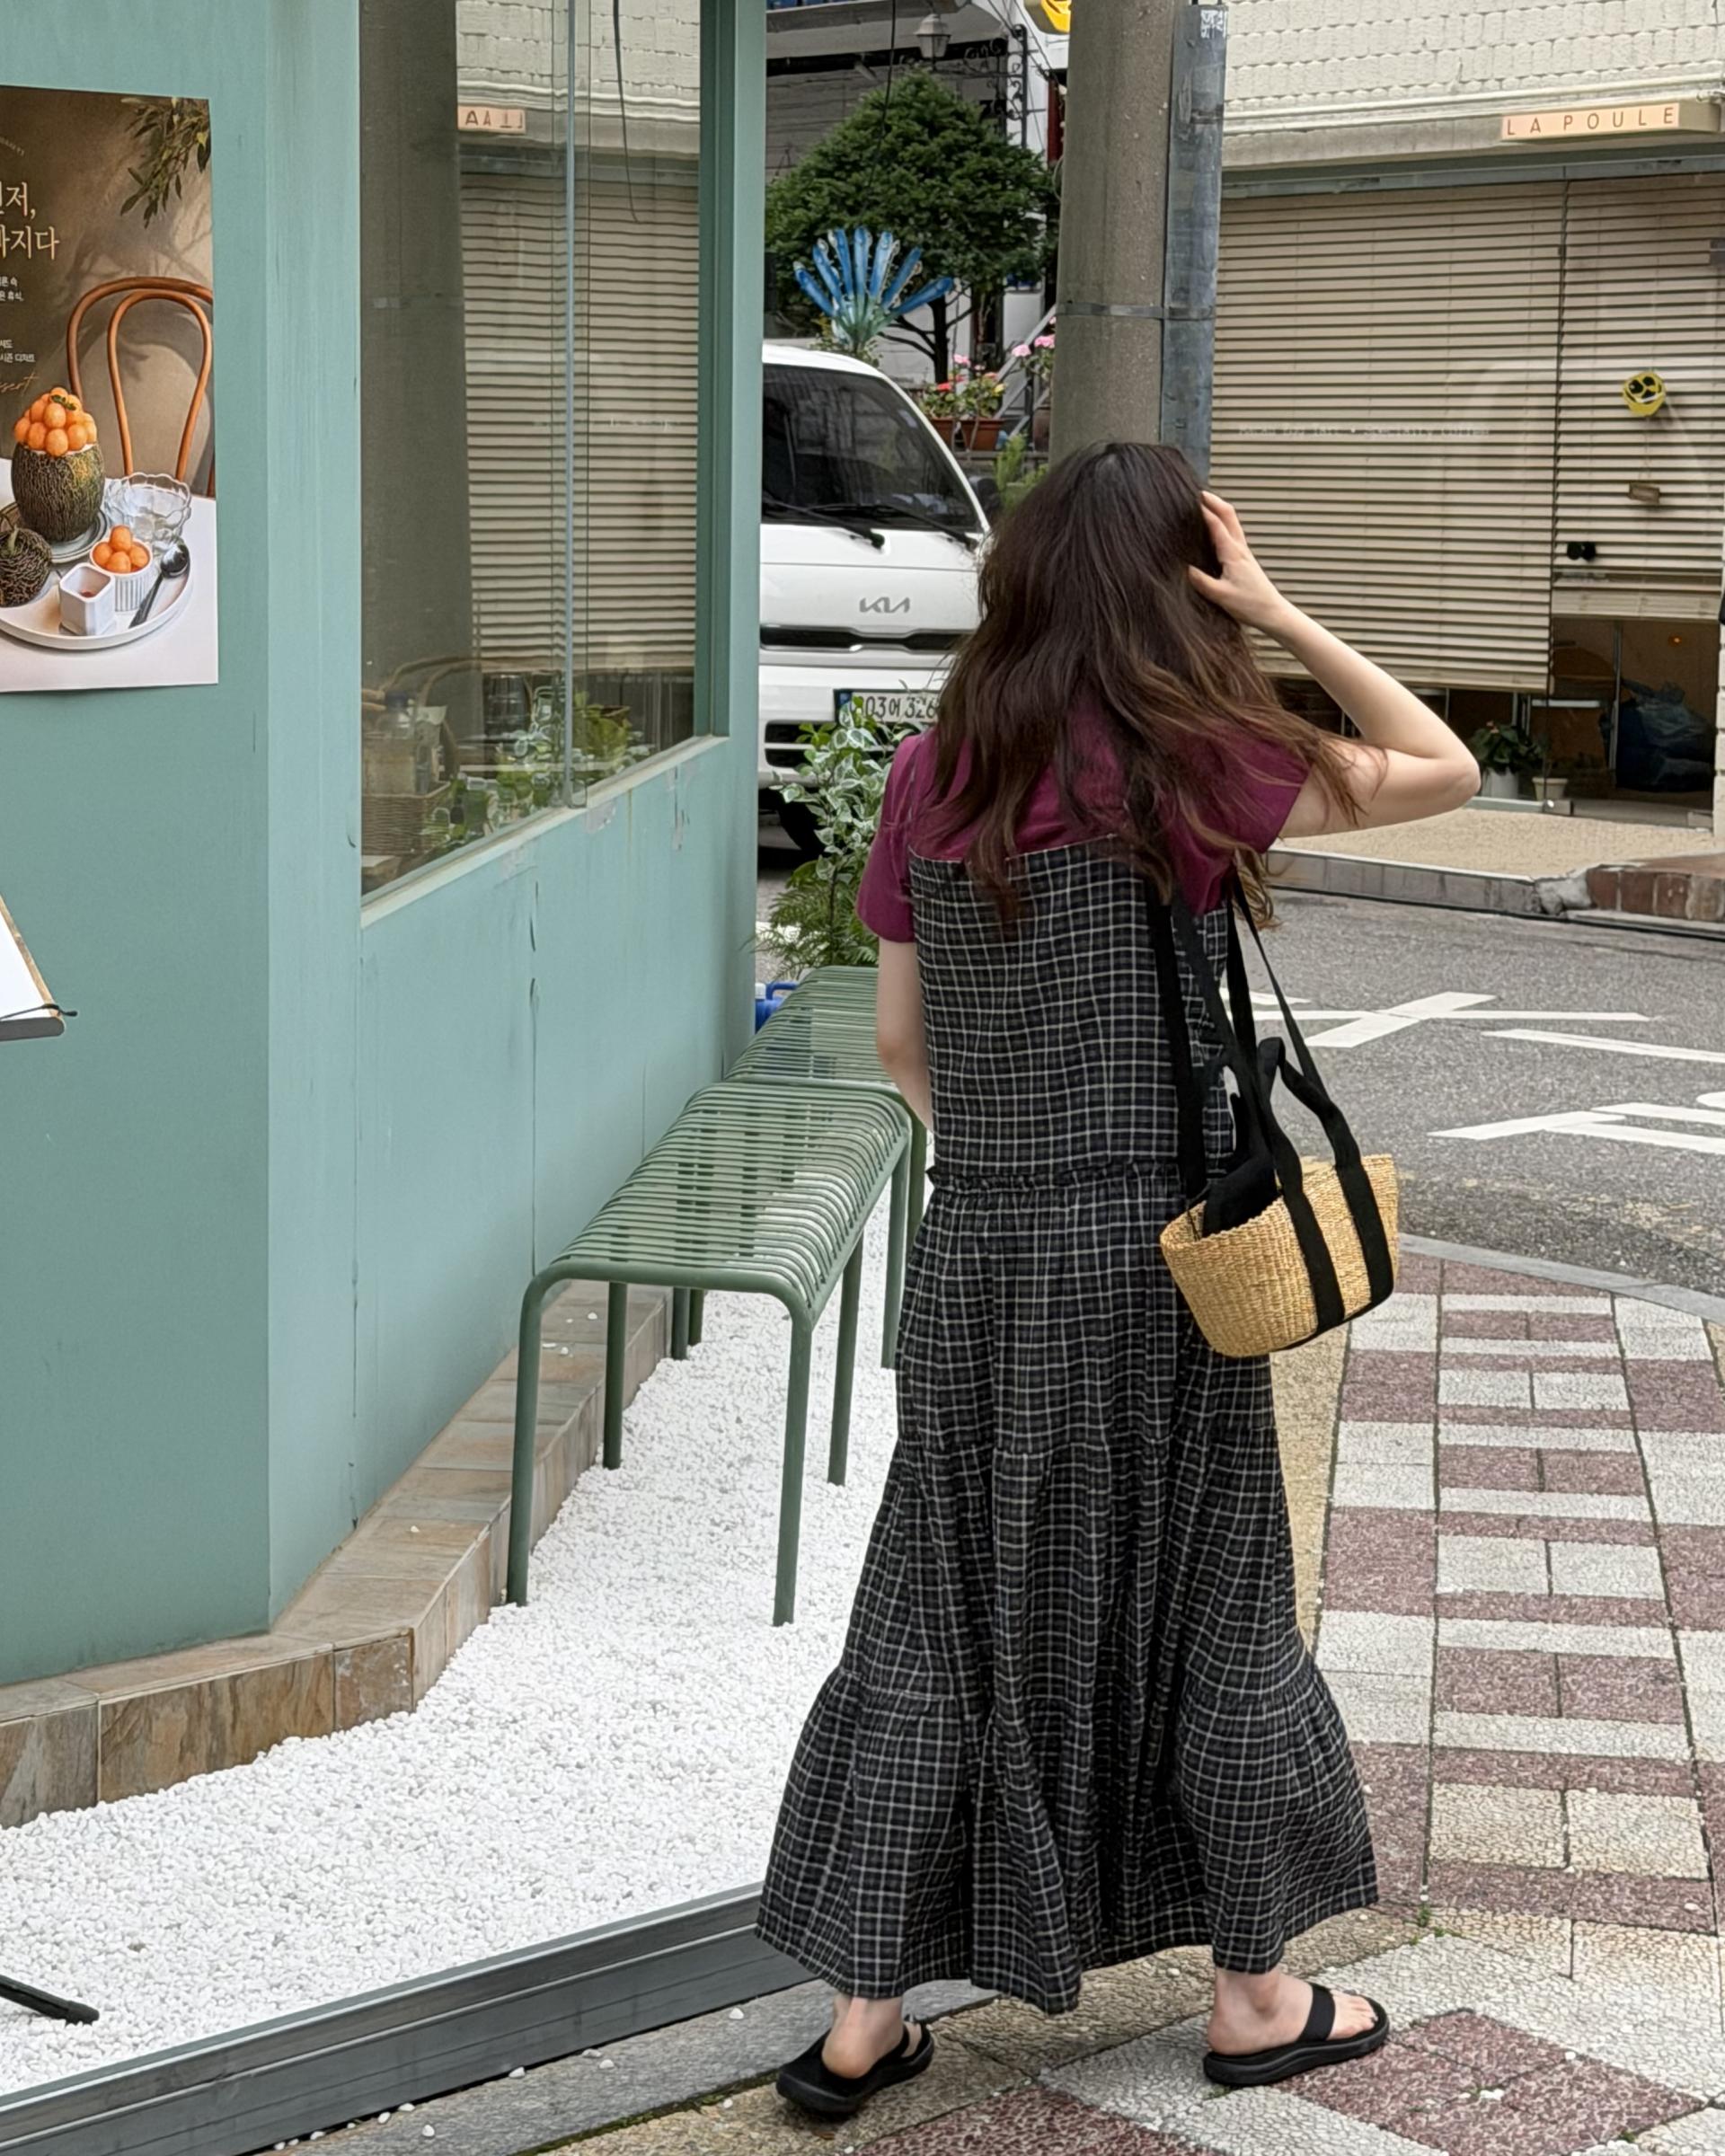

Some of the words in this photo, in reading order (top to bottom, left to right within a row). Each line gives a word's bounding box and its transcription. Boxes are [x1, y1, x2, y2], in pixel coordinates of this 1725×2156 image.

[1506, 117, 1542, 136] LA
[1562, 107, 1674, 131] POULE
[0, 181, 36, 218] 저,
[859, 596, 910, 614] KIA
